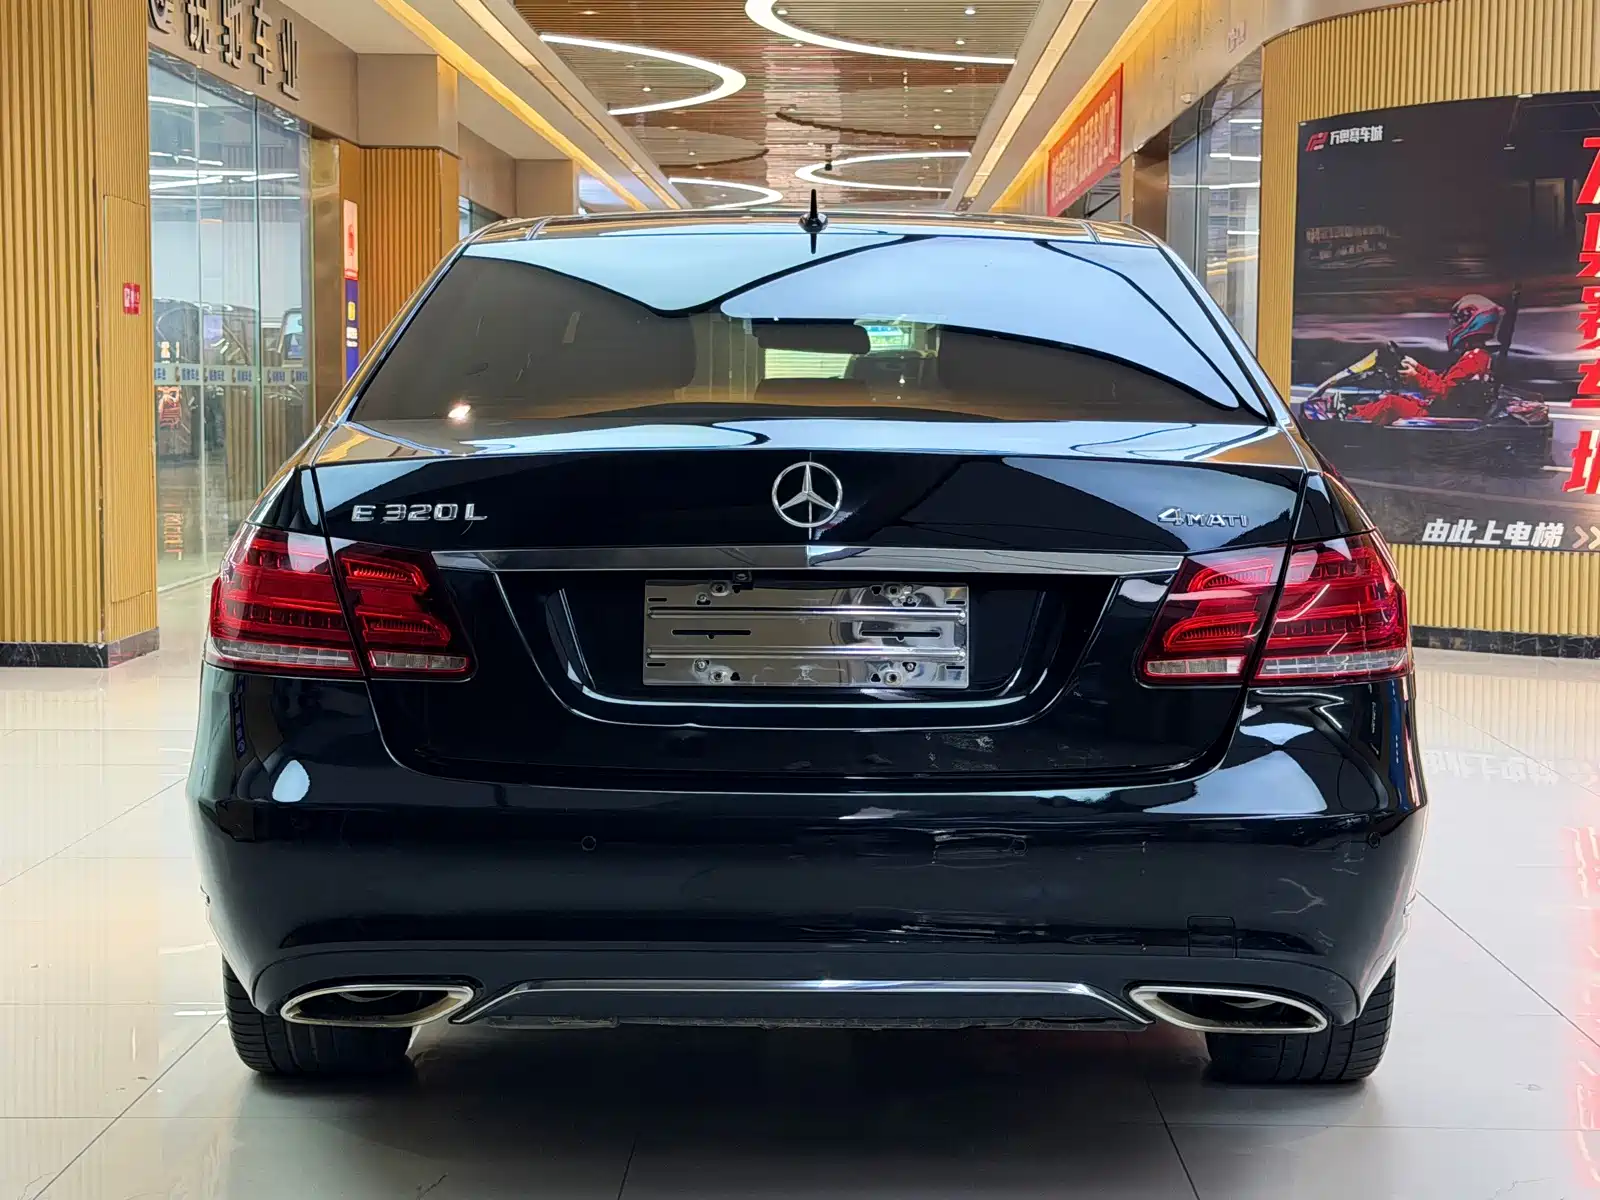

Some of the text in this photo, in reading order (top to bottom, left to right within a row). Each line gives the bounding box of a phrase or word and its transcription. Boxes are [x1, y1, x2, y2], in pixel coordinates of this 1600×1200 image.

[1329, 125, 1384, 146] 万奥赛车城
[351, 504, 377, 522] E
[1422, 518, 1565, 548] 由此上电梯
